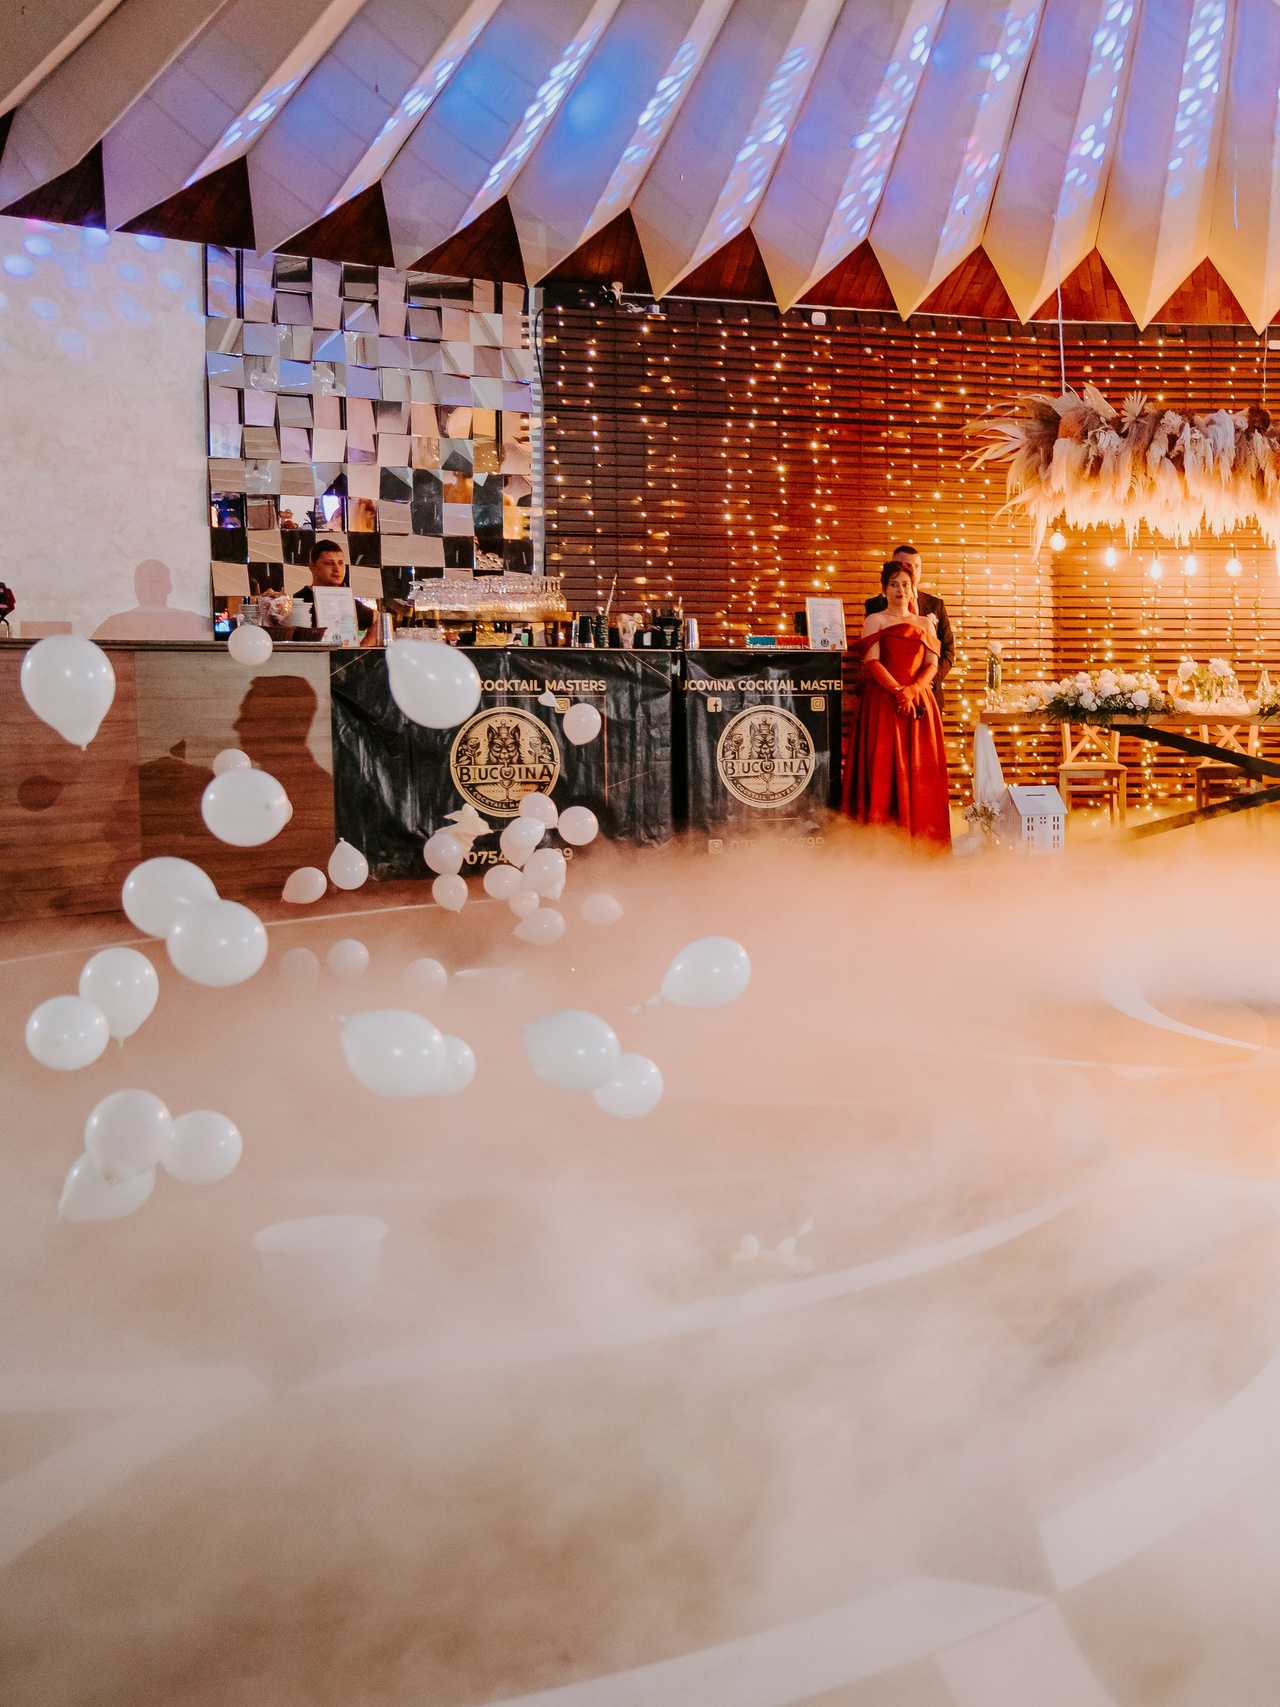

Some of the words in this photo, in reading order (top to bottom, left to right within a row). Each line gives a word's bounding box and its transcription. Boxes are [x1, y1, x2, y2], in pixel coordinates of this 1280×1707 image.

[545, 679, 606, 691] MASTERS
[738, 680, 798, 691] COCKTAIL
[801, 680, 843, 691] MASTE
